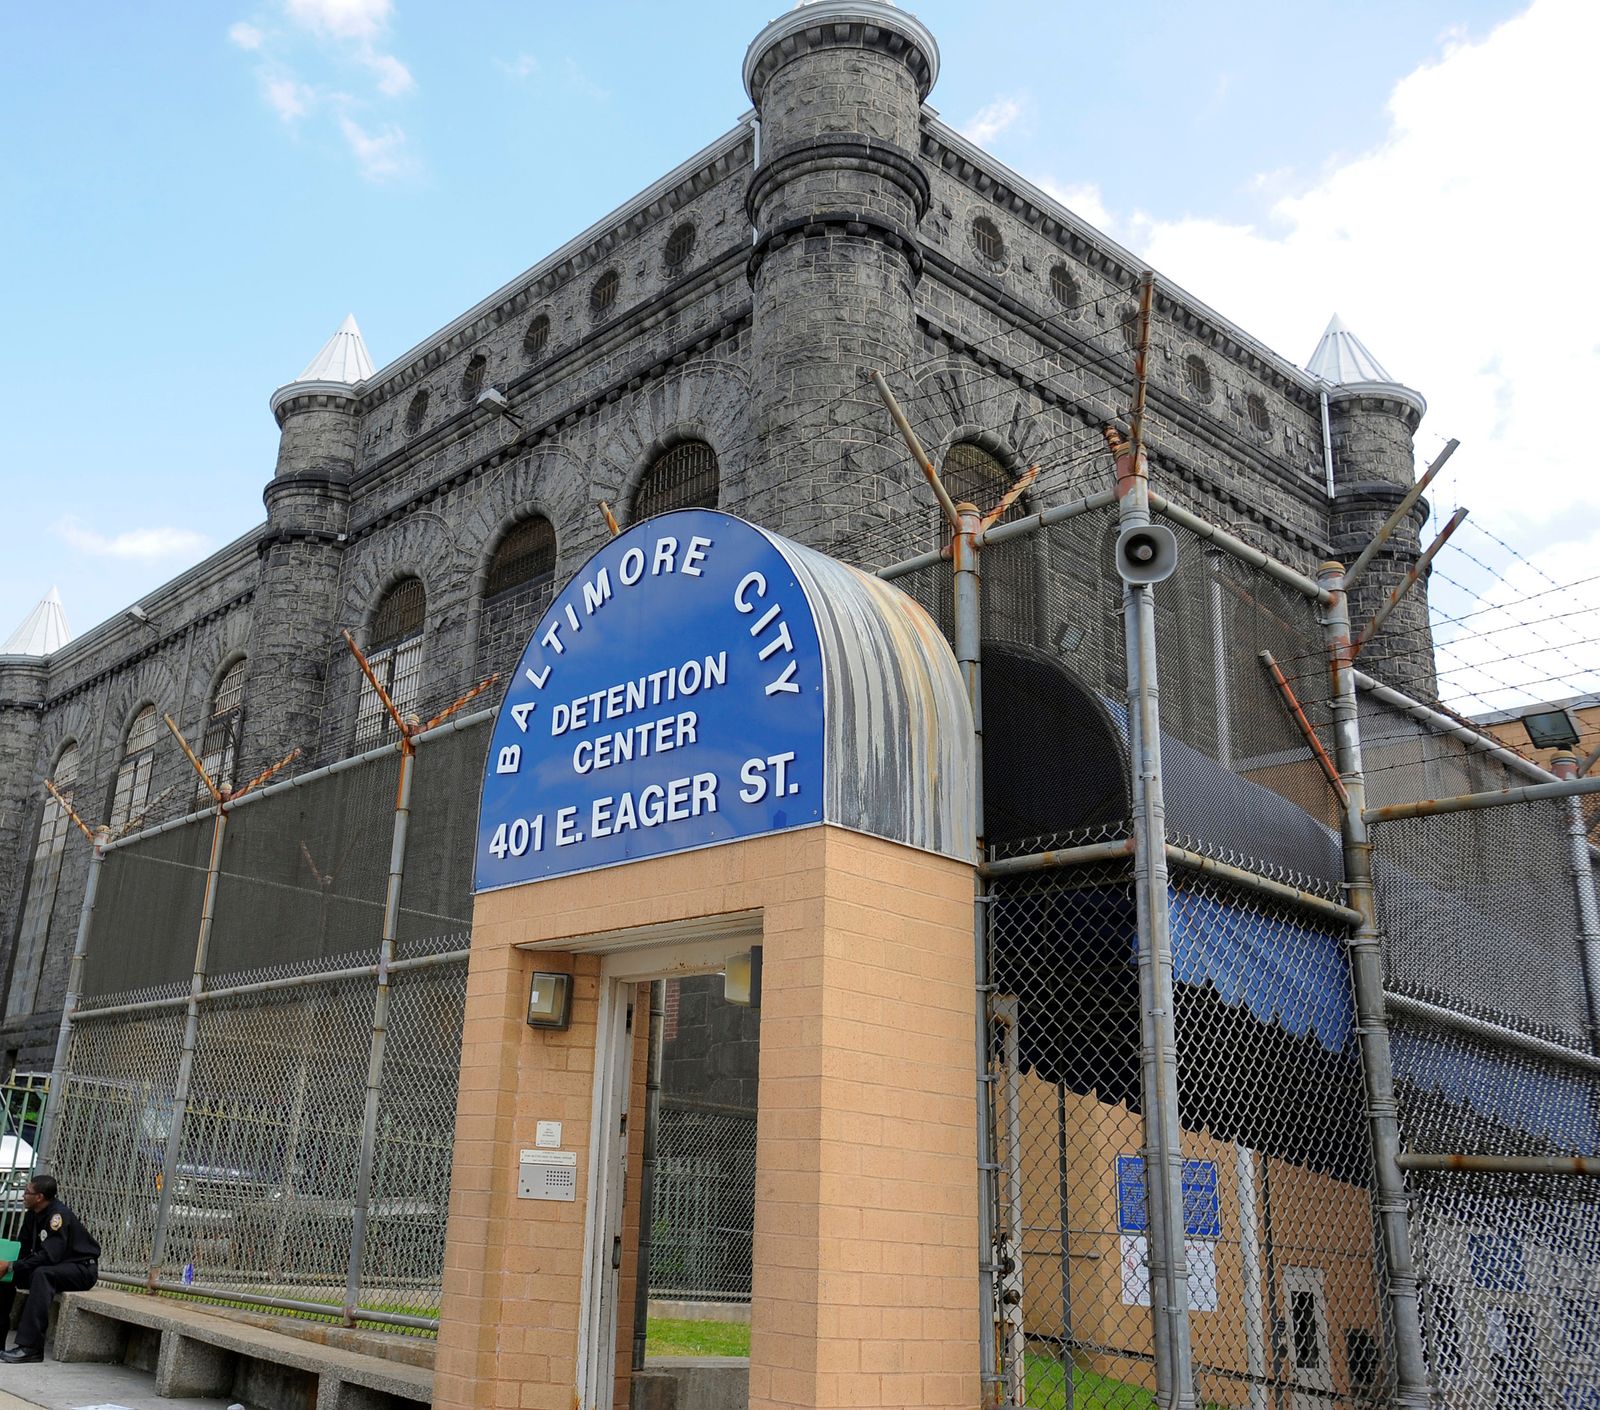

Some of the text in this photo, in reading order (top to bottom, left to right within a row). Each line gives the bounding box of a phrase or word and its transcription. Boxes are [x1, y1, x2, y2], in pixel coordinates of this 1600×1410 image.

[496, 536, 799, 774] BALTIMORE CITY
[551, 651, 727, 737] DETENTION
[572, 711, 698, 775] CENTER
[489, 751, 799, 859] 401 E. EAGER ST.
